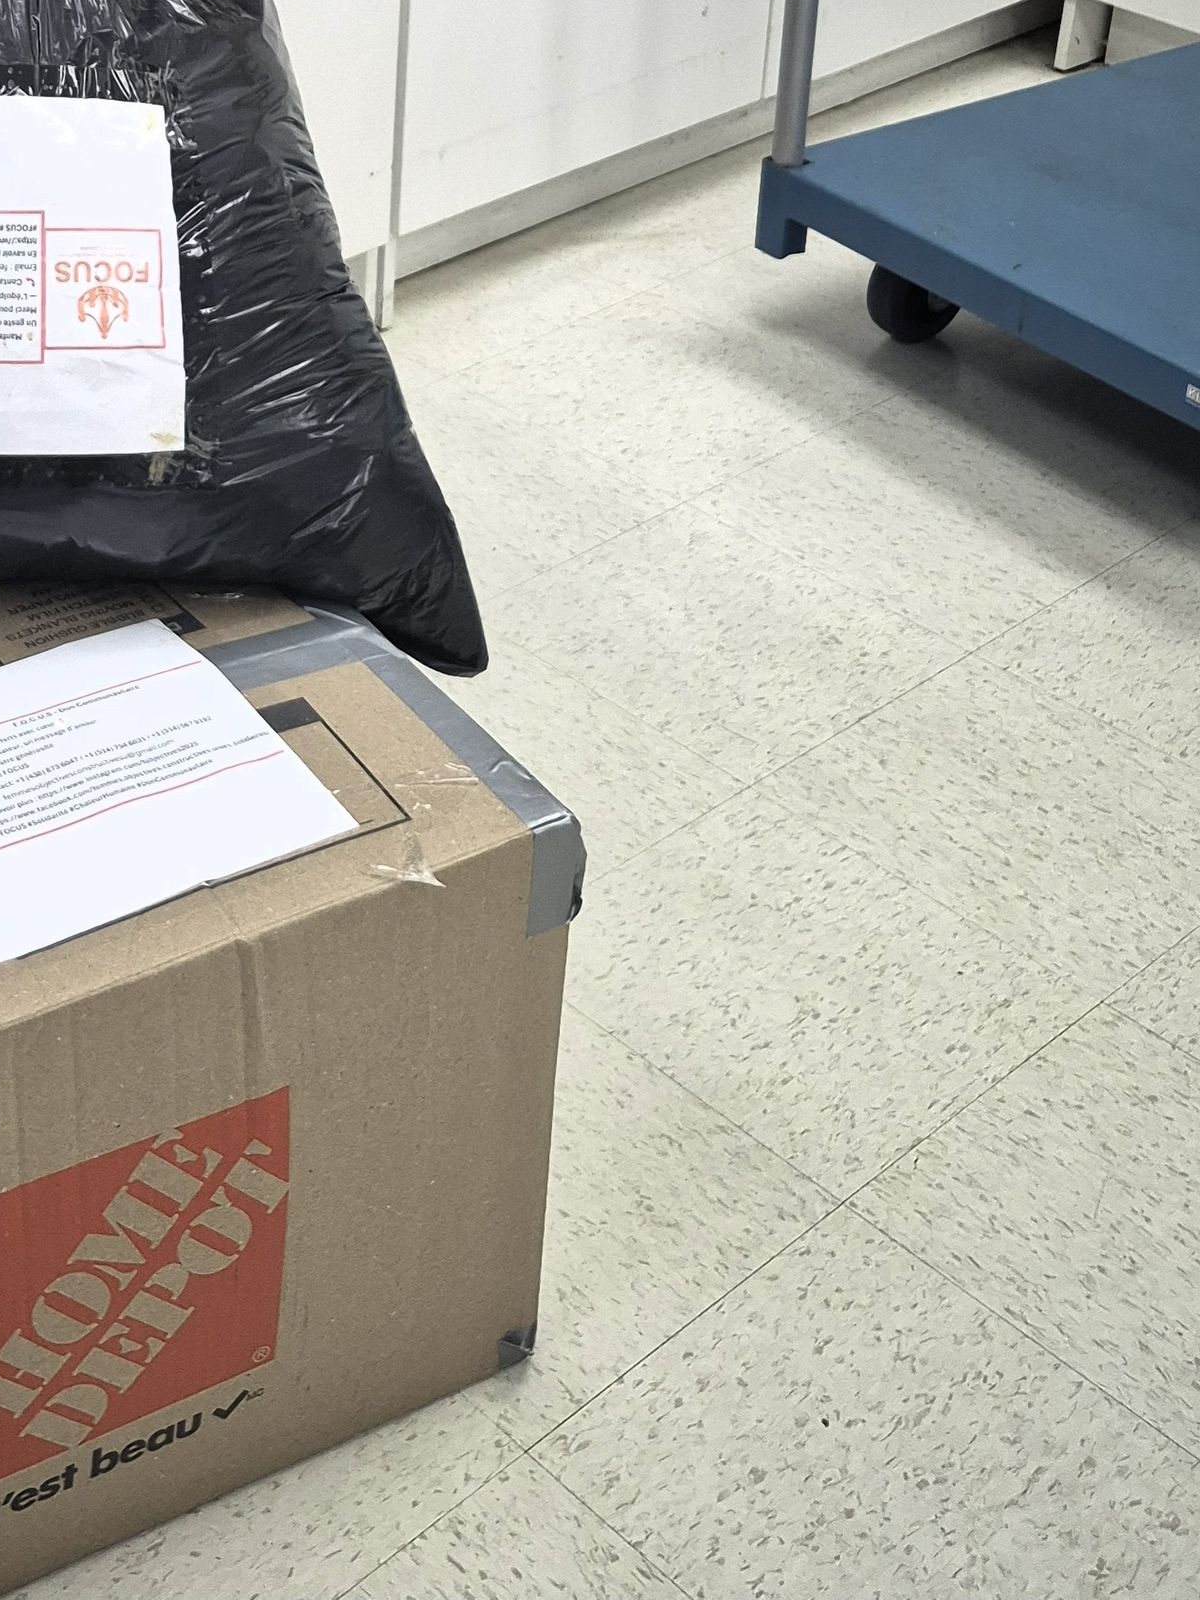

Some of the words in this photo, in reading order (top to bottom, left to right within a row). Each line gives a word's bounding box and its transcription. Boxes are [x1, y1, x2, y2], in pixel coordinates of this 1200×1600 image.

[54, 261, 149, 283] FOCUS
[3, 317, 24, 326] geste
[26, 319, 37, 327] Un
[4, 615, 78, 642] BLANKETS
[23, 624, 88, 649] CUSHION
[16, 1138, 289, 1449] DEPOT
[88, 1412, 202, 1478] beau
